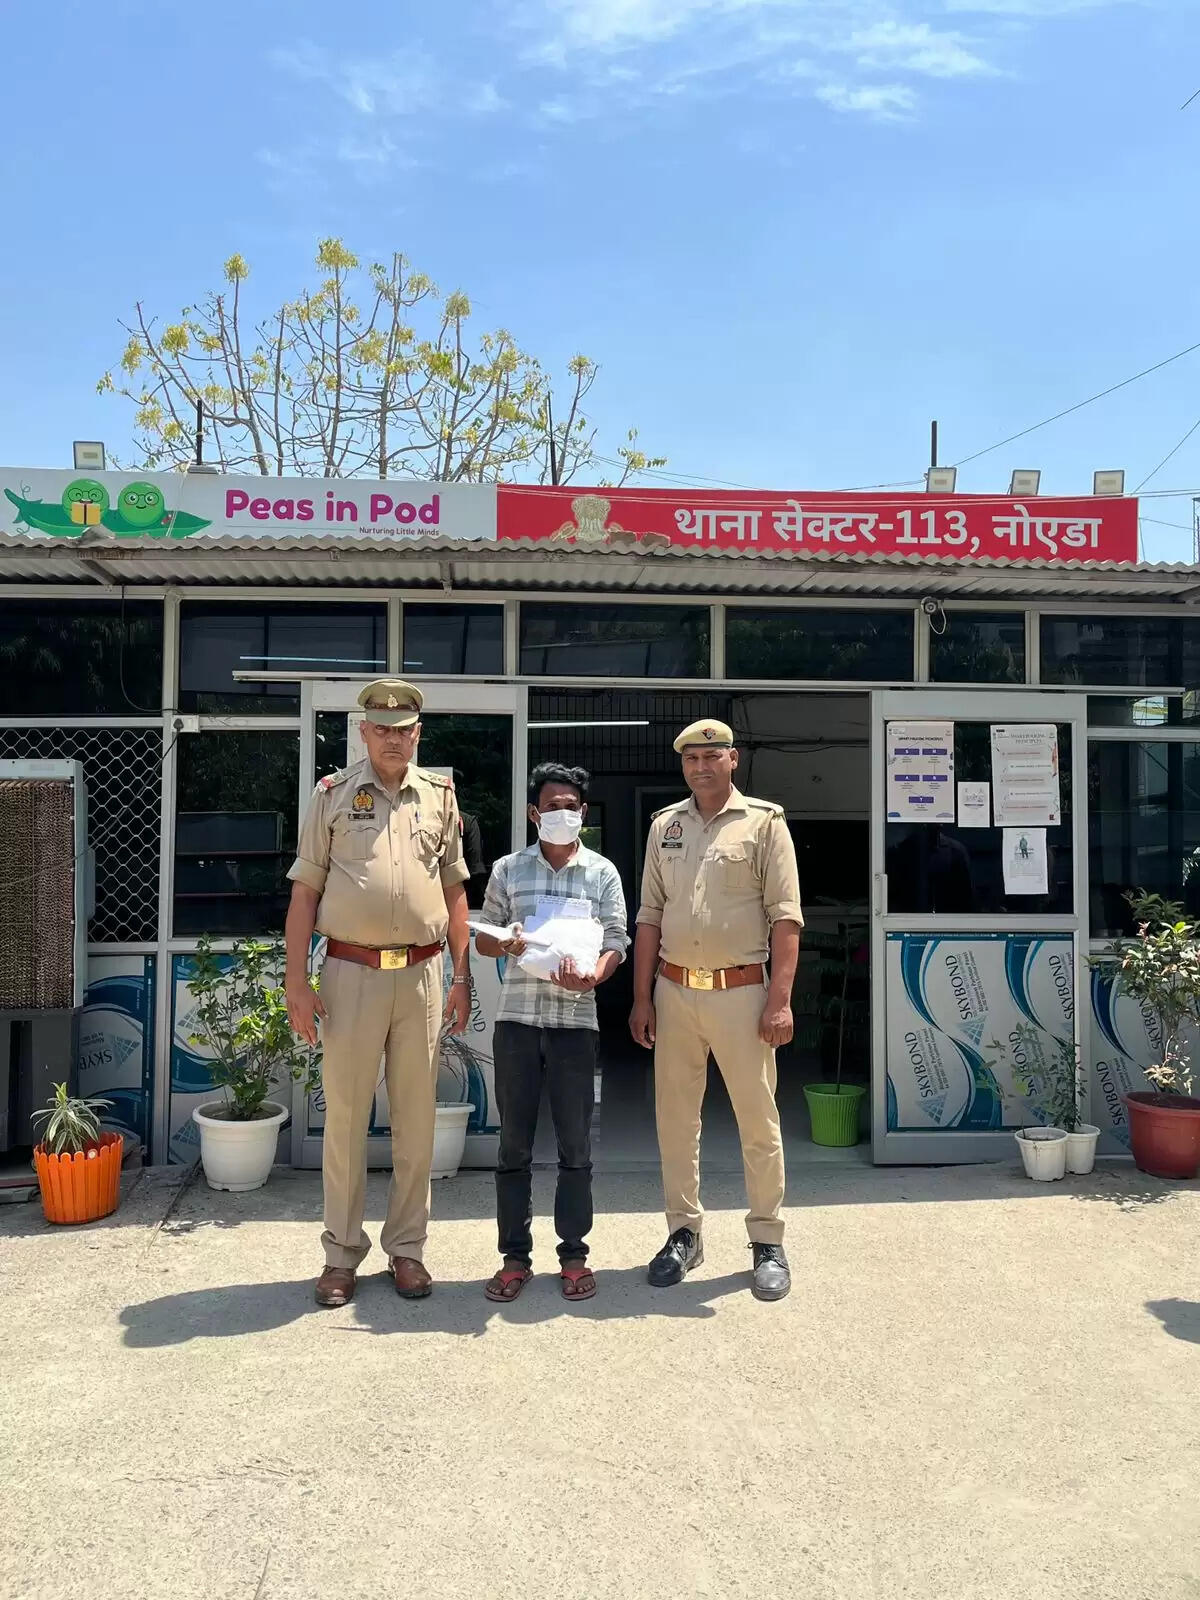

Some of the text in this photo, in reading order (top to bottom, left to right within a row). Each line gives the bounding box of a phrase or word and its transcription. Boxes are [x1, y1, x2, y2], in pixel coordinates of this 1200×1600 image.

[226, 489, 440, 525] Peas in Pod
[359, 526, 440, 537] Nurturing Little Minds
[674, 499, 1103, 555] थाना सेक्टर-113, नोएडा
[945, 954, 973, 1020] SKYBOND
[904, 1031, 934, 1098] SKYBOND
[1095, 1060, 1126, 1126] SKYBOND
